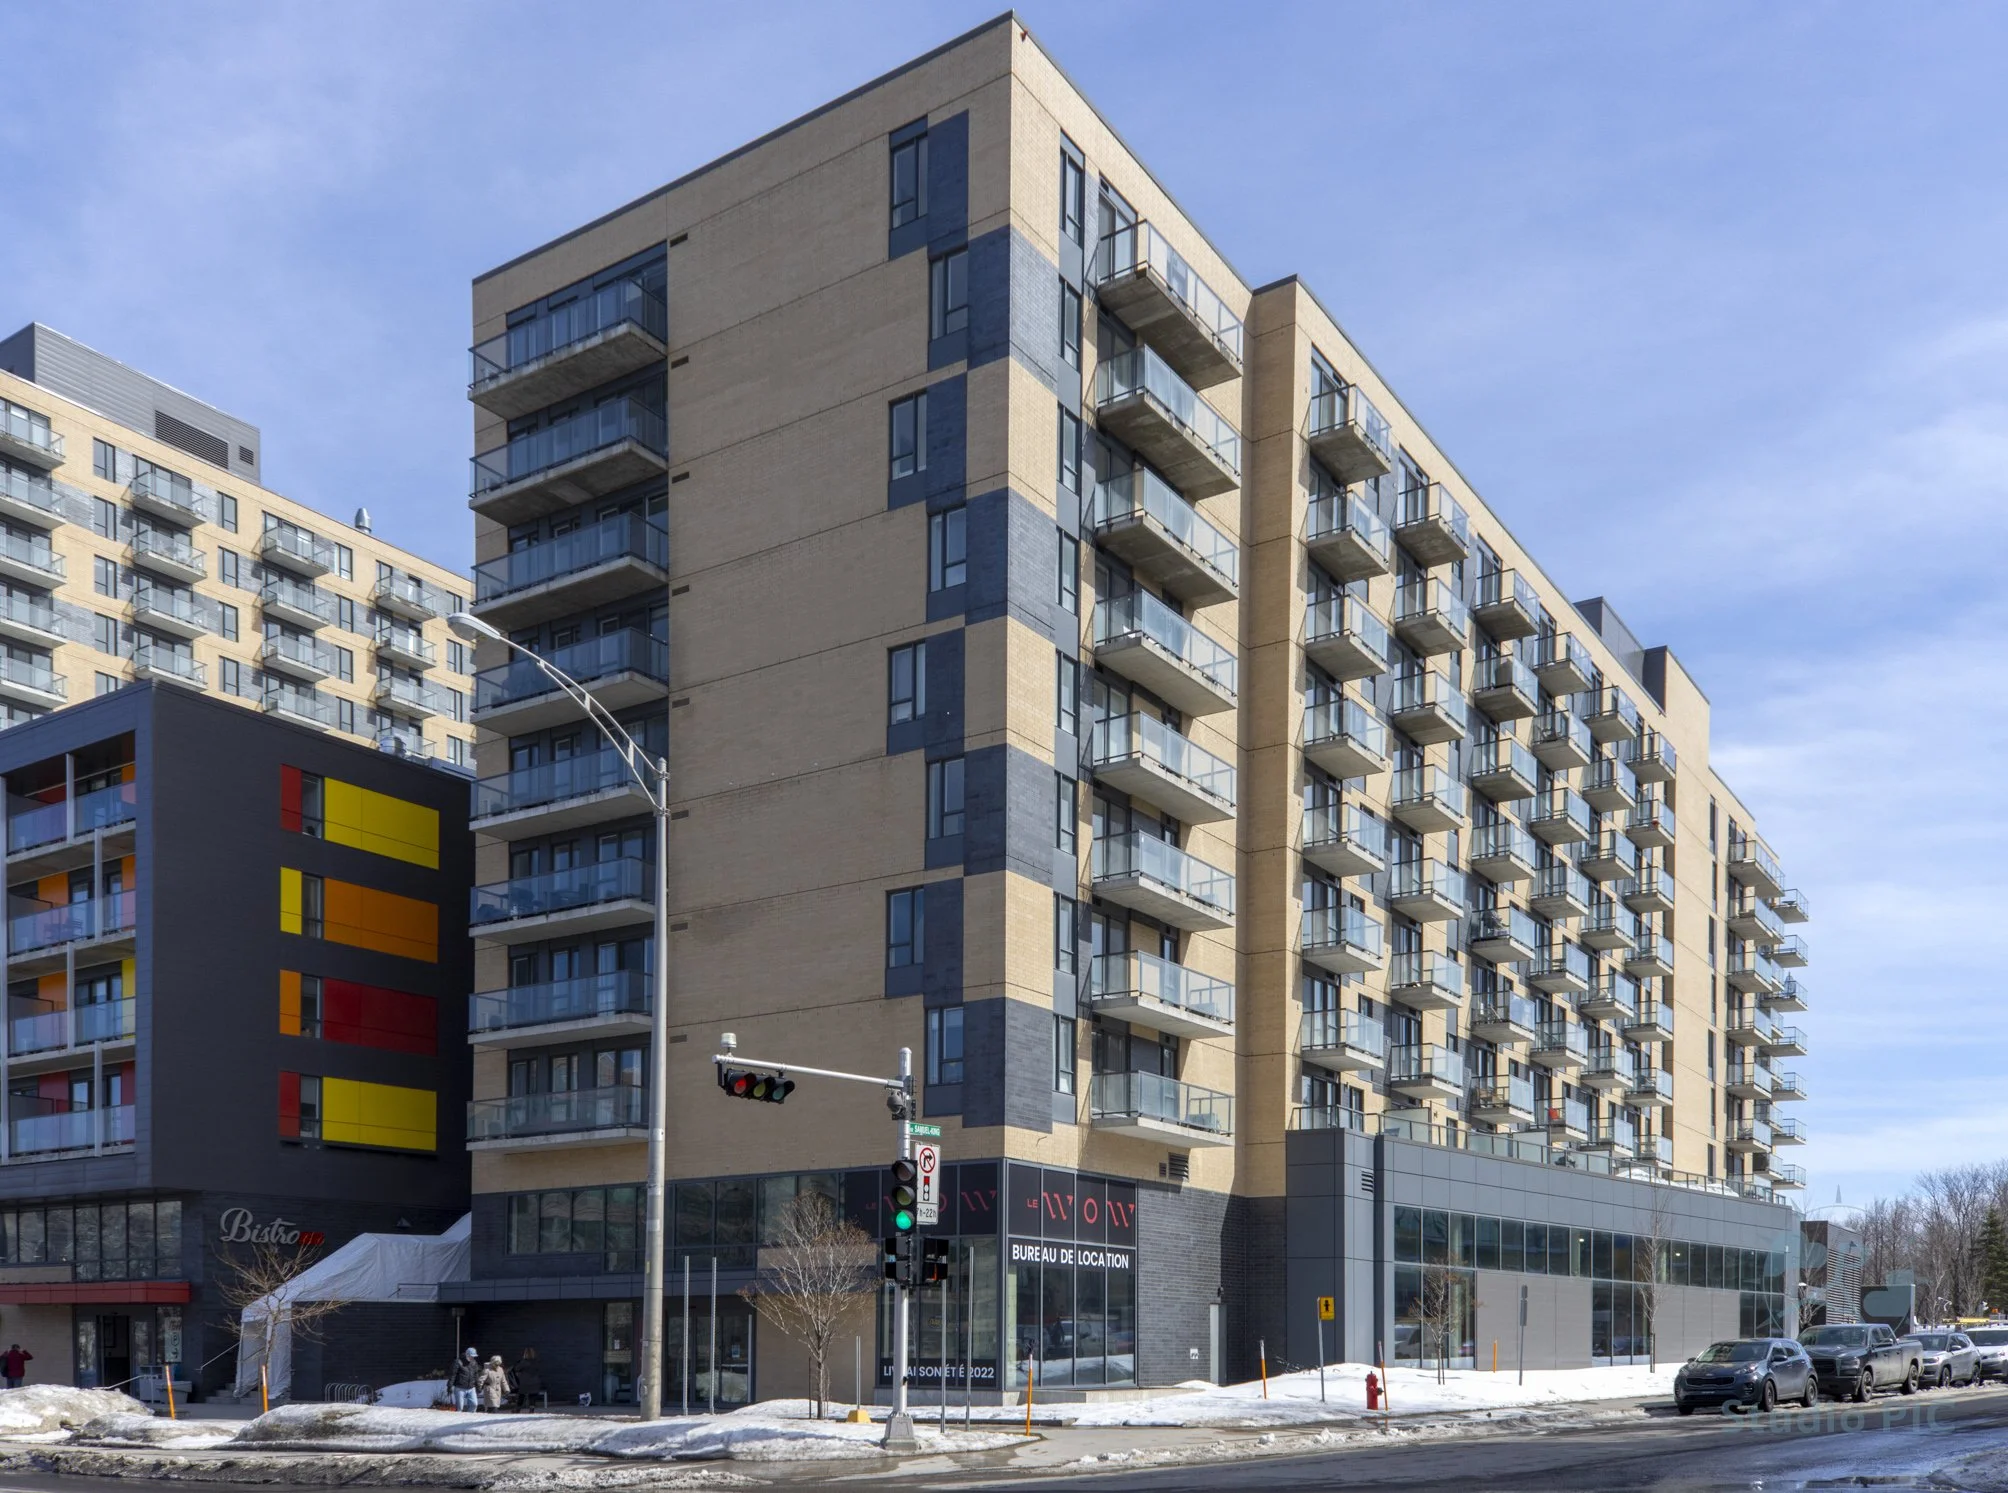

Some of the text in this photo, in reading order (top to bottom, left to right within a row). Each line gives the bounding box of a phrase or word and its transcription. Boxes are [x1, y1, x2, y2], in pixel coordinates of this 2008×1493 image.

[1027, 1198, 1039, 1209] LE
[220, 1207, 301, 1245] Bistro
[1012, 1244, 1129, 1269] BUREAU DE LOCATION
[883, 1365, 942, 1378] LIAISON
